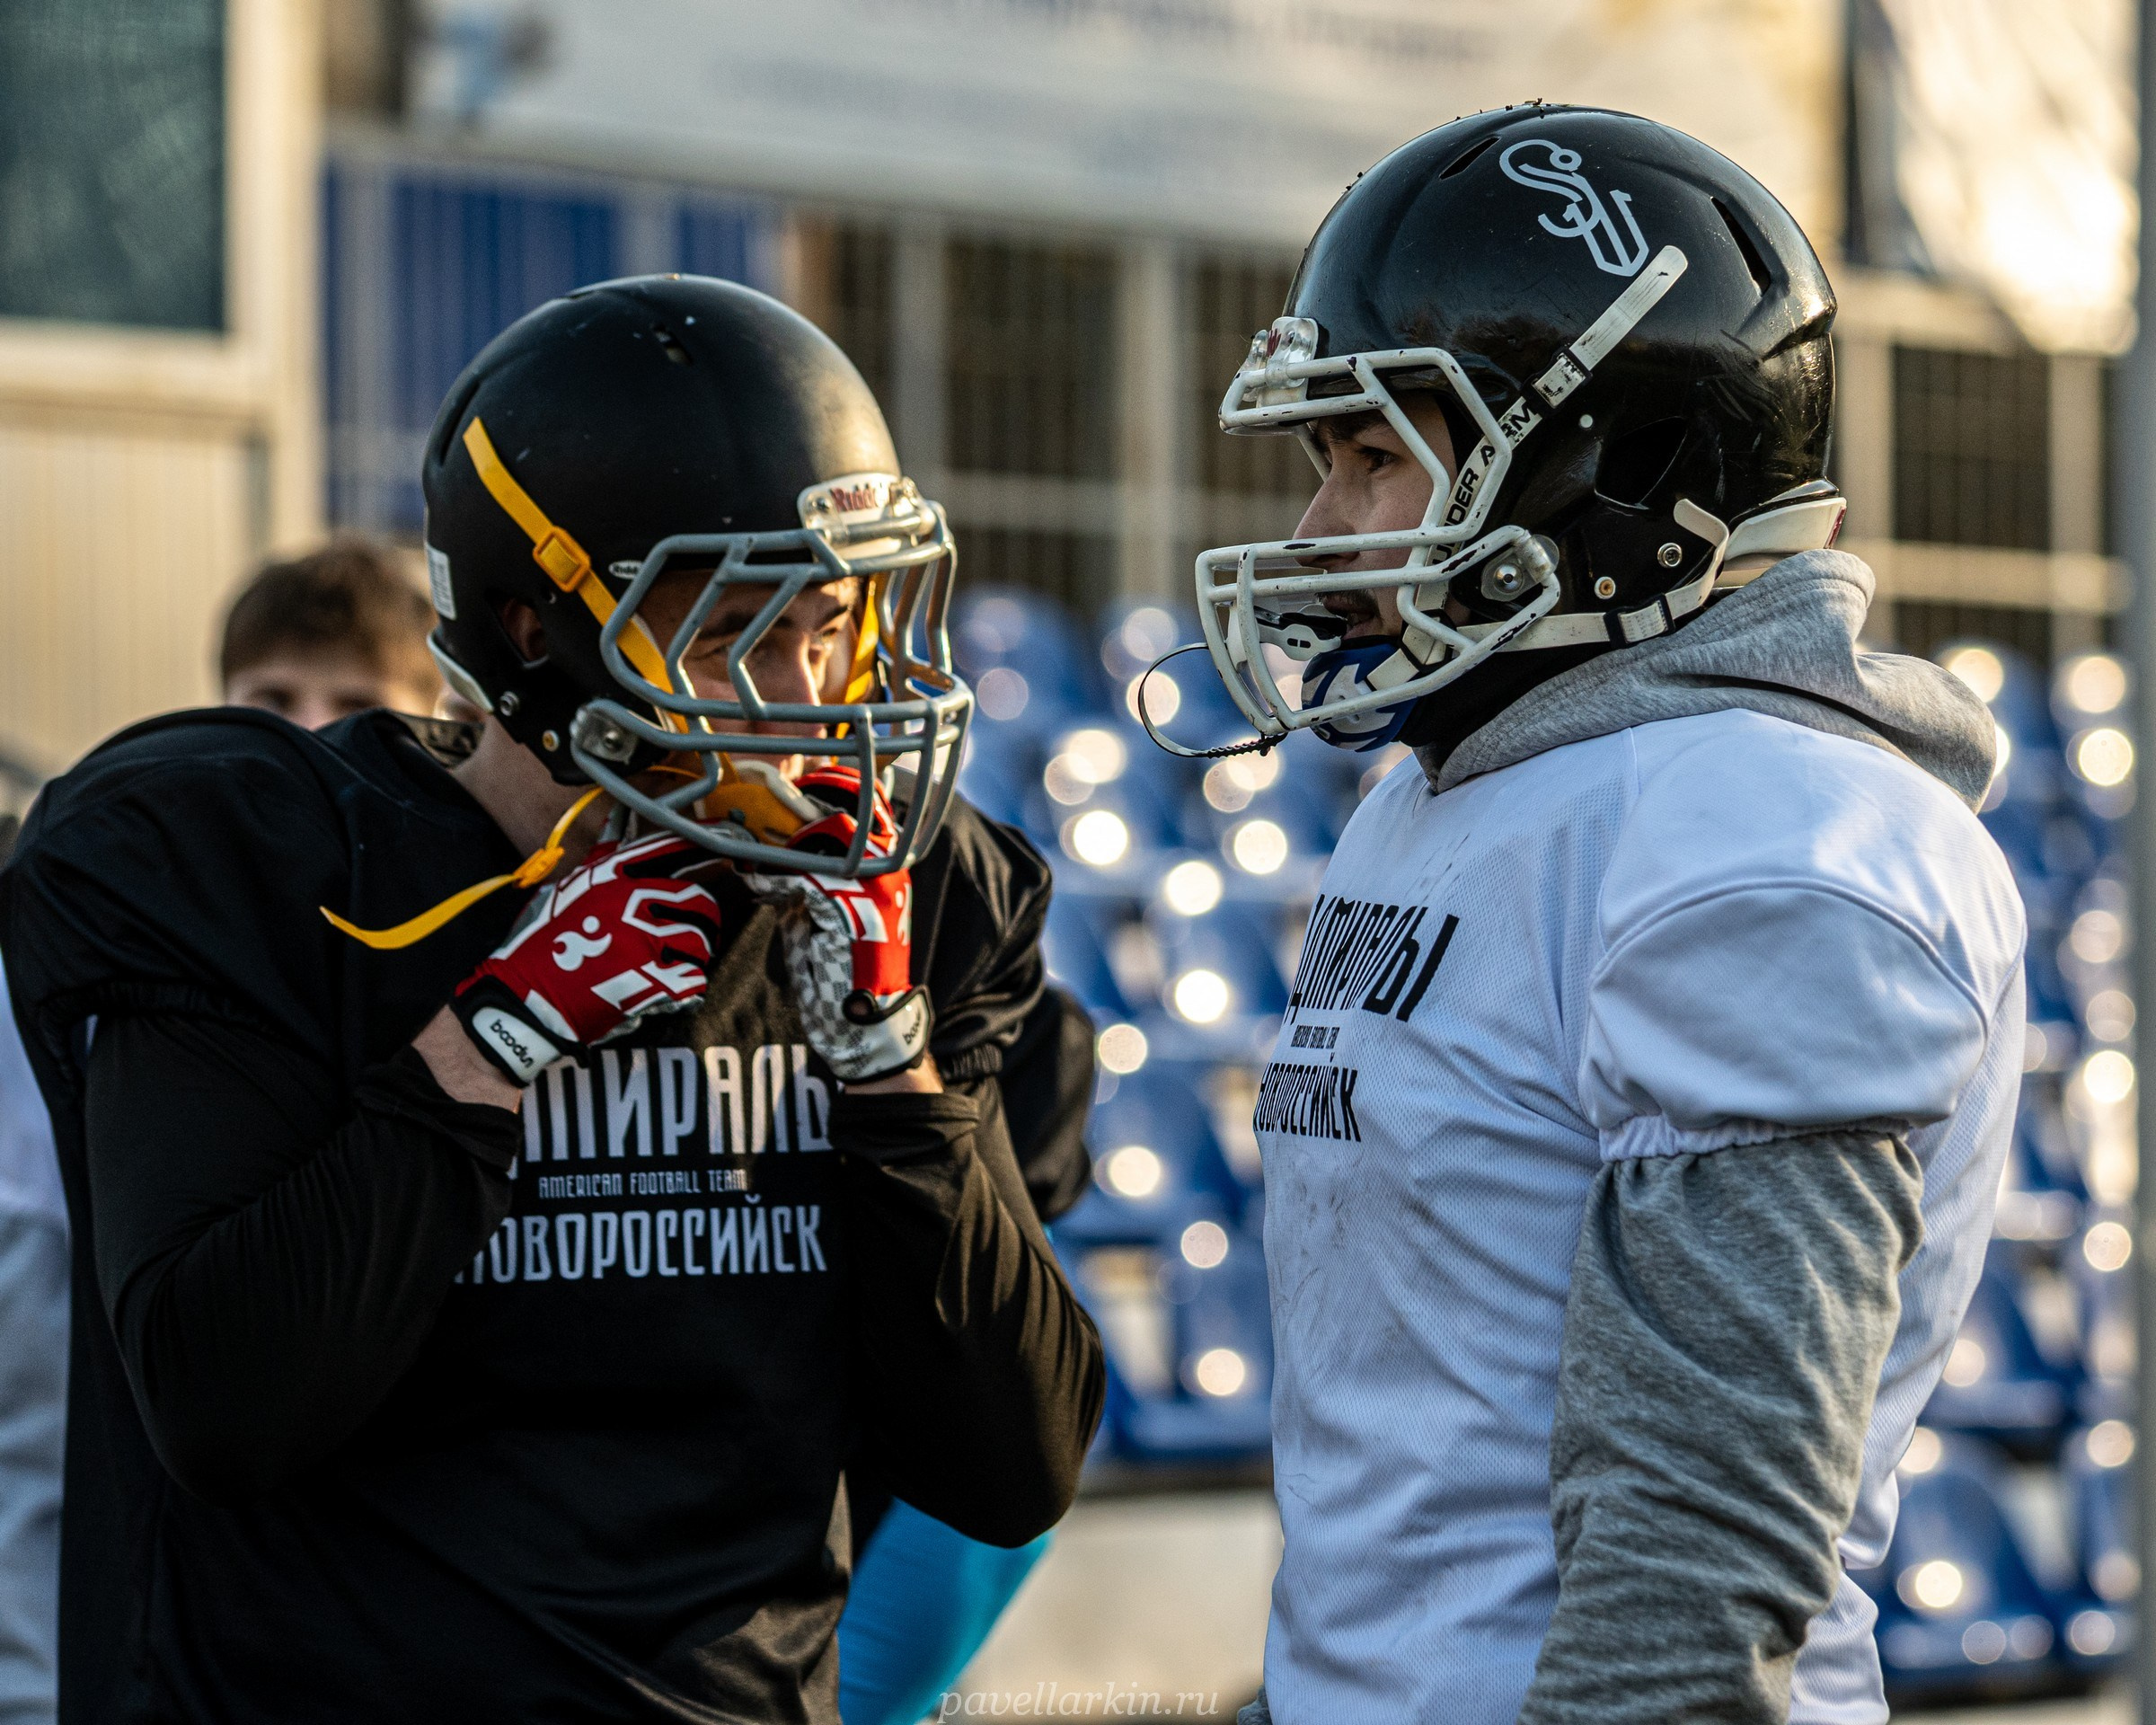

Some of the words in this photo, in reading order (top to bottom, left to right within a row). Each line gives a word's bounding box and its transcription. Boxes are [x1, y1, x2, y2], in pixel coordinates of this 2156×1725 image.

[1432, 467, 1480, 564] UDER
[539, 1173, 623, 1199] AMERICAN
[631, 1171, 702, 1195] FOOTBALL
[707, 1169, 747, 1192] TEAM
